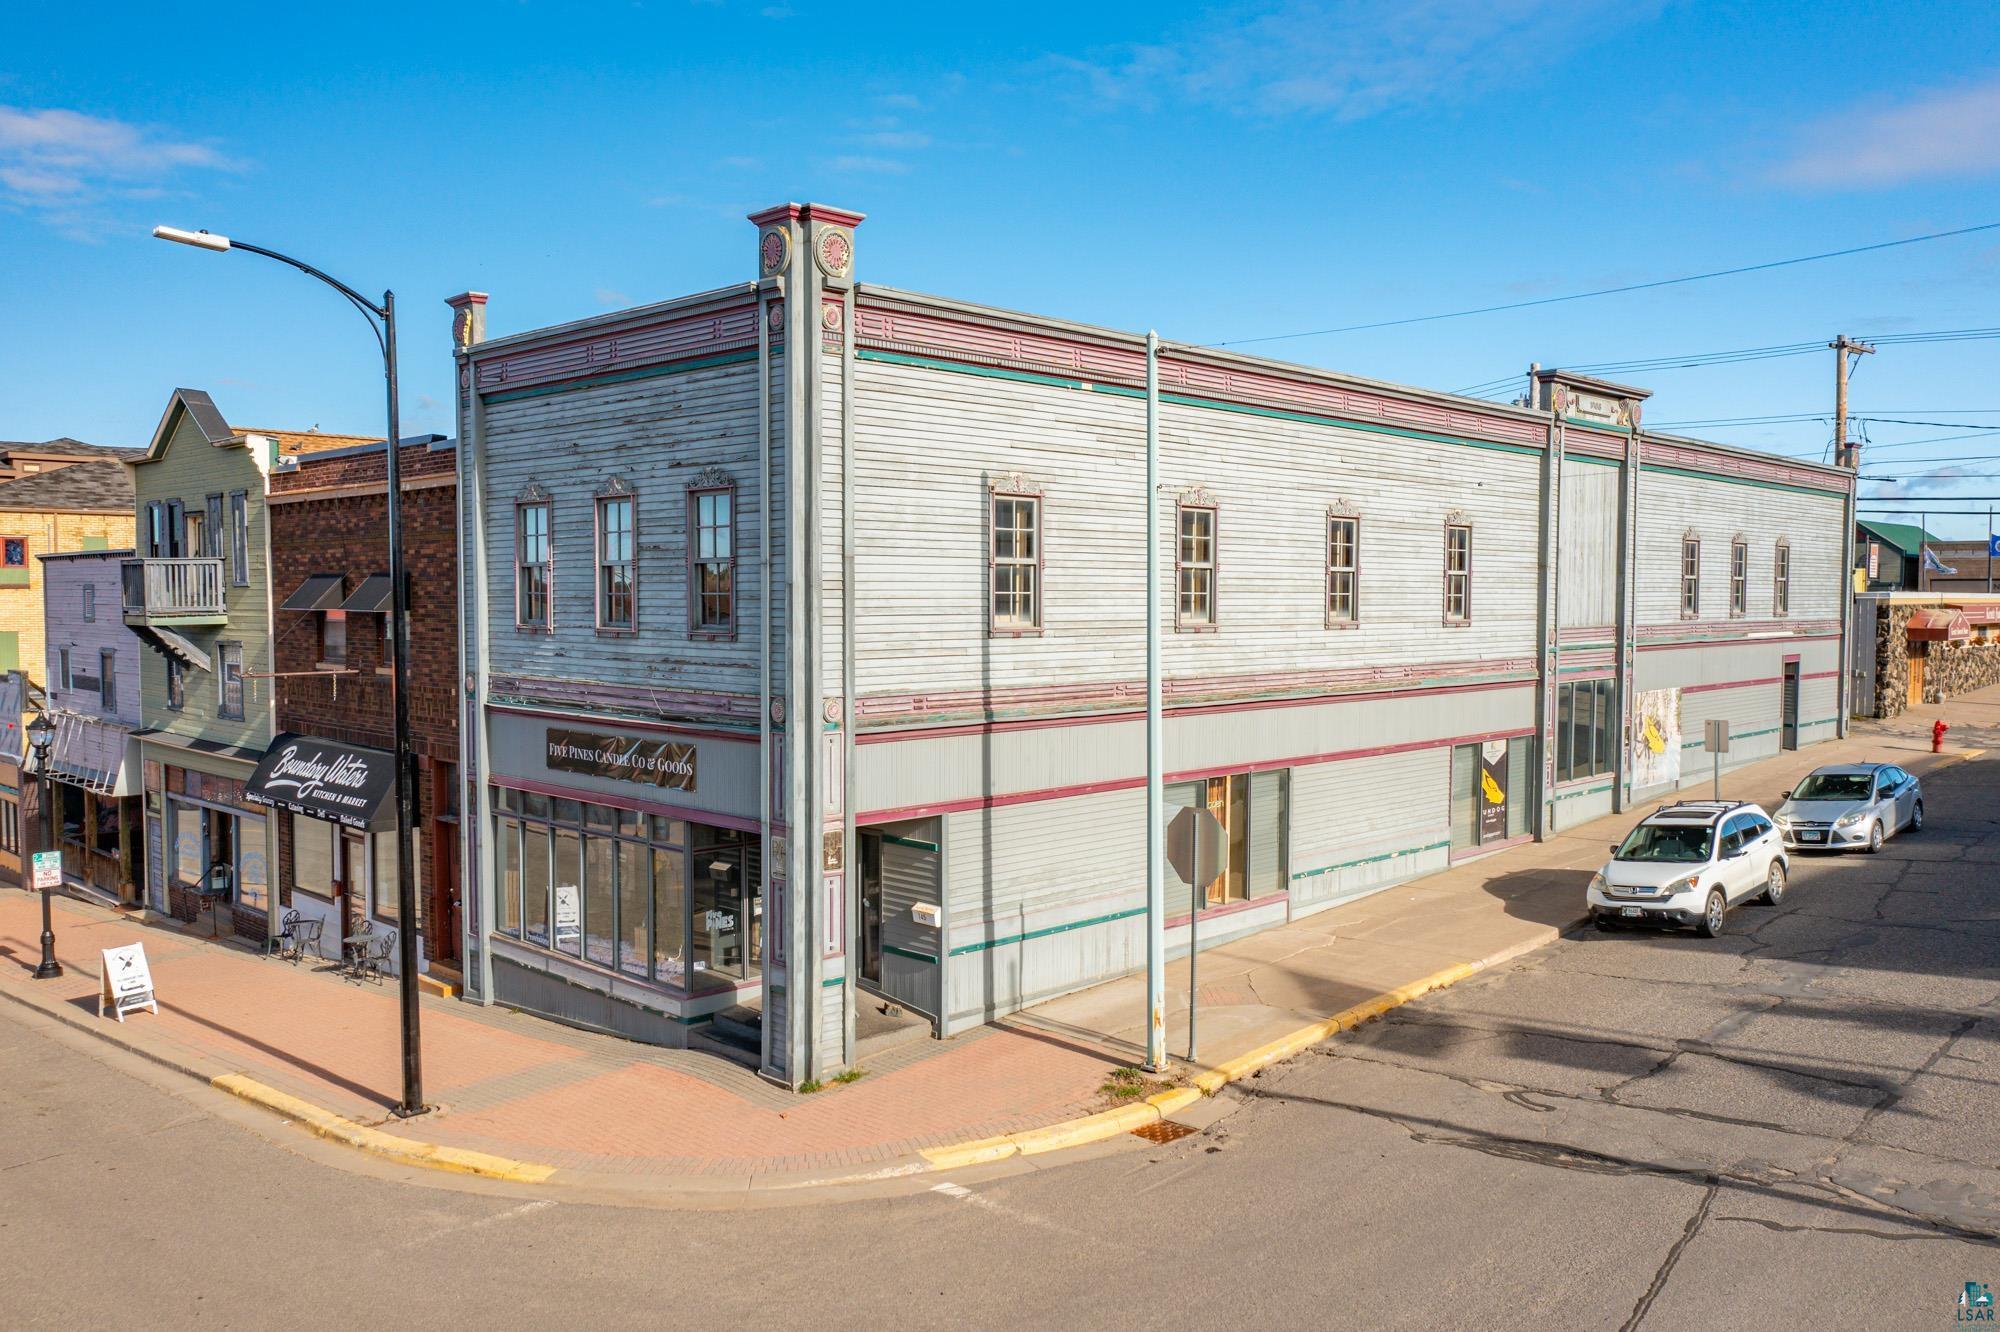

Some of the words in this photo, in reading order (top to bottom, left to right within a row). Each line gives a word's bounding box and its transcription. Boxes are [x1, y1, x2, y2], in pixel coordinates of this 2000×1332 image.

[266, 745, 328, 798] Boundary
[324, 754, 368, 788] Waters
[549, 743, 567, 757] FIVE
[569, 745, 594, 762] PINES
[595, 749, 630, 767] CANDLE
[632, 754, 645, 769] CO
[647, 758, 656, 770] &
[657, 757, 693, 775] GOODS
[312, 789, 337, 801] KITCHEN
[336, 794, 342, 803] &
[341, 795, 367, 807] MARKET
